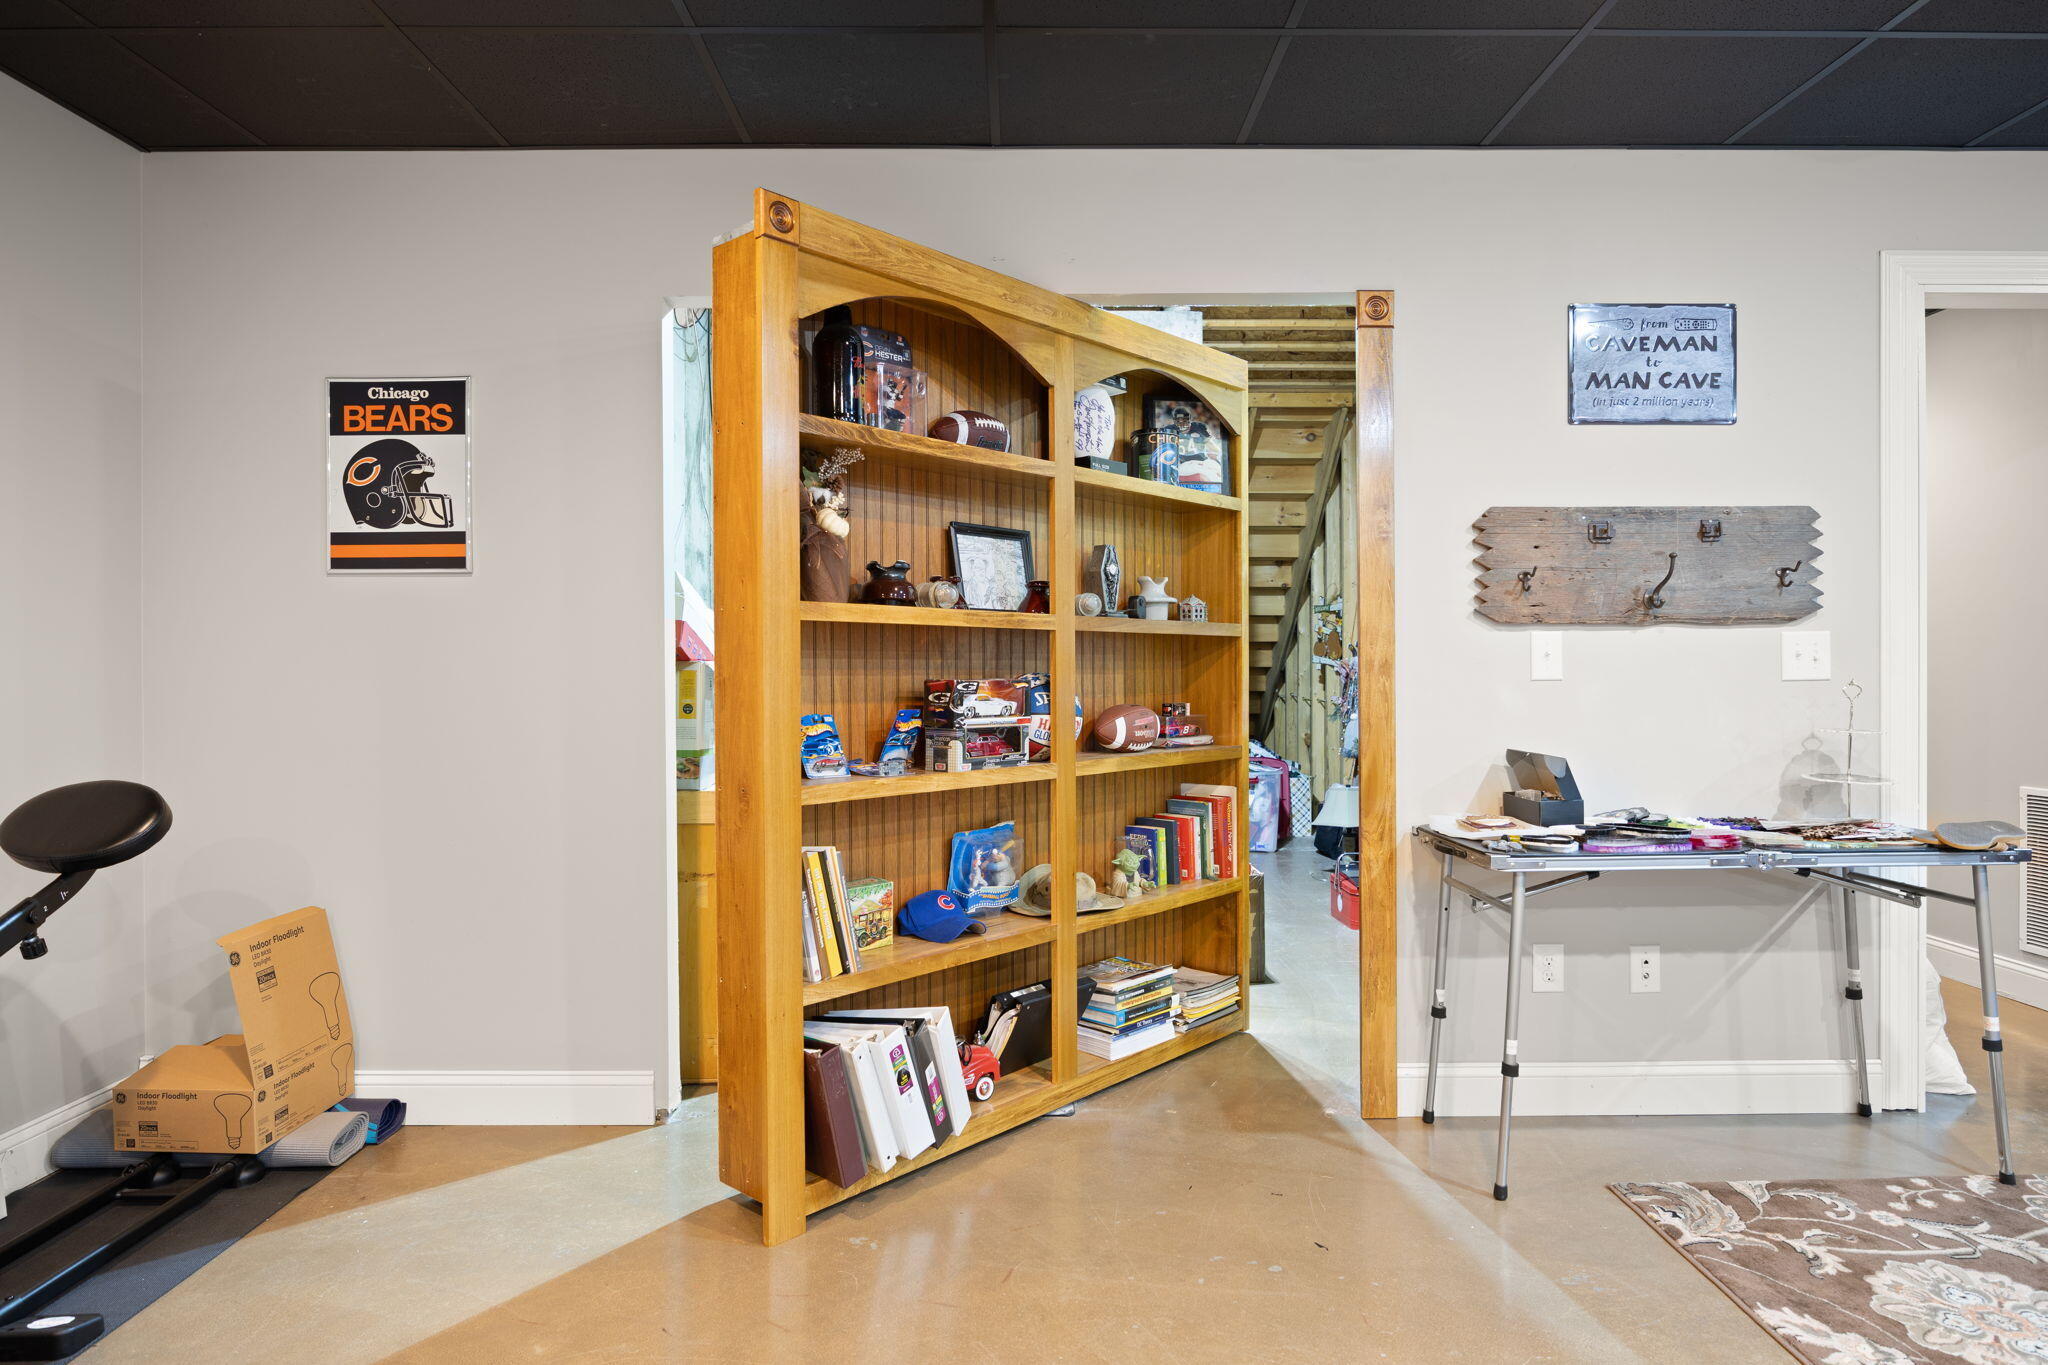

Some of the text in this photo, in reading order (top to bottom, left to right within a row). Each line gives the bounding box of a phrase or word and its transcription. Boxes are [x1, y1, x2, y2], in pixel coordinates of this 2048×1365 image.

[1640, 318, 1668, 332] from
[1585, 335, 1718, 352] CAVEMAN
[874, 350, 904, 362] HESTER
[1646, 356, 1663, 367] to
[1585, 371, 1722, 390] MAN CAVE
[367, 386, 430, 401] Chicago
[1608, 397, 1629, 407] just
[1632, 396, 1639, 406] 2
[1641, 396, 1678, 406] million
[343, 403, 454, 432] BEARS
[1182, 726, 1190, 734] 8
[249, 925, 305, 952] Indoor Floodlight
[251, 951, 261, 960] LED
[253, 956, 272, 967] Daylight
[274, 1062, 315, 1089] Indoor Floodlight
[162, 1092, 198, 1101] Floodlight
